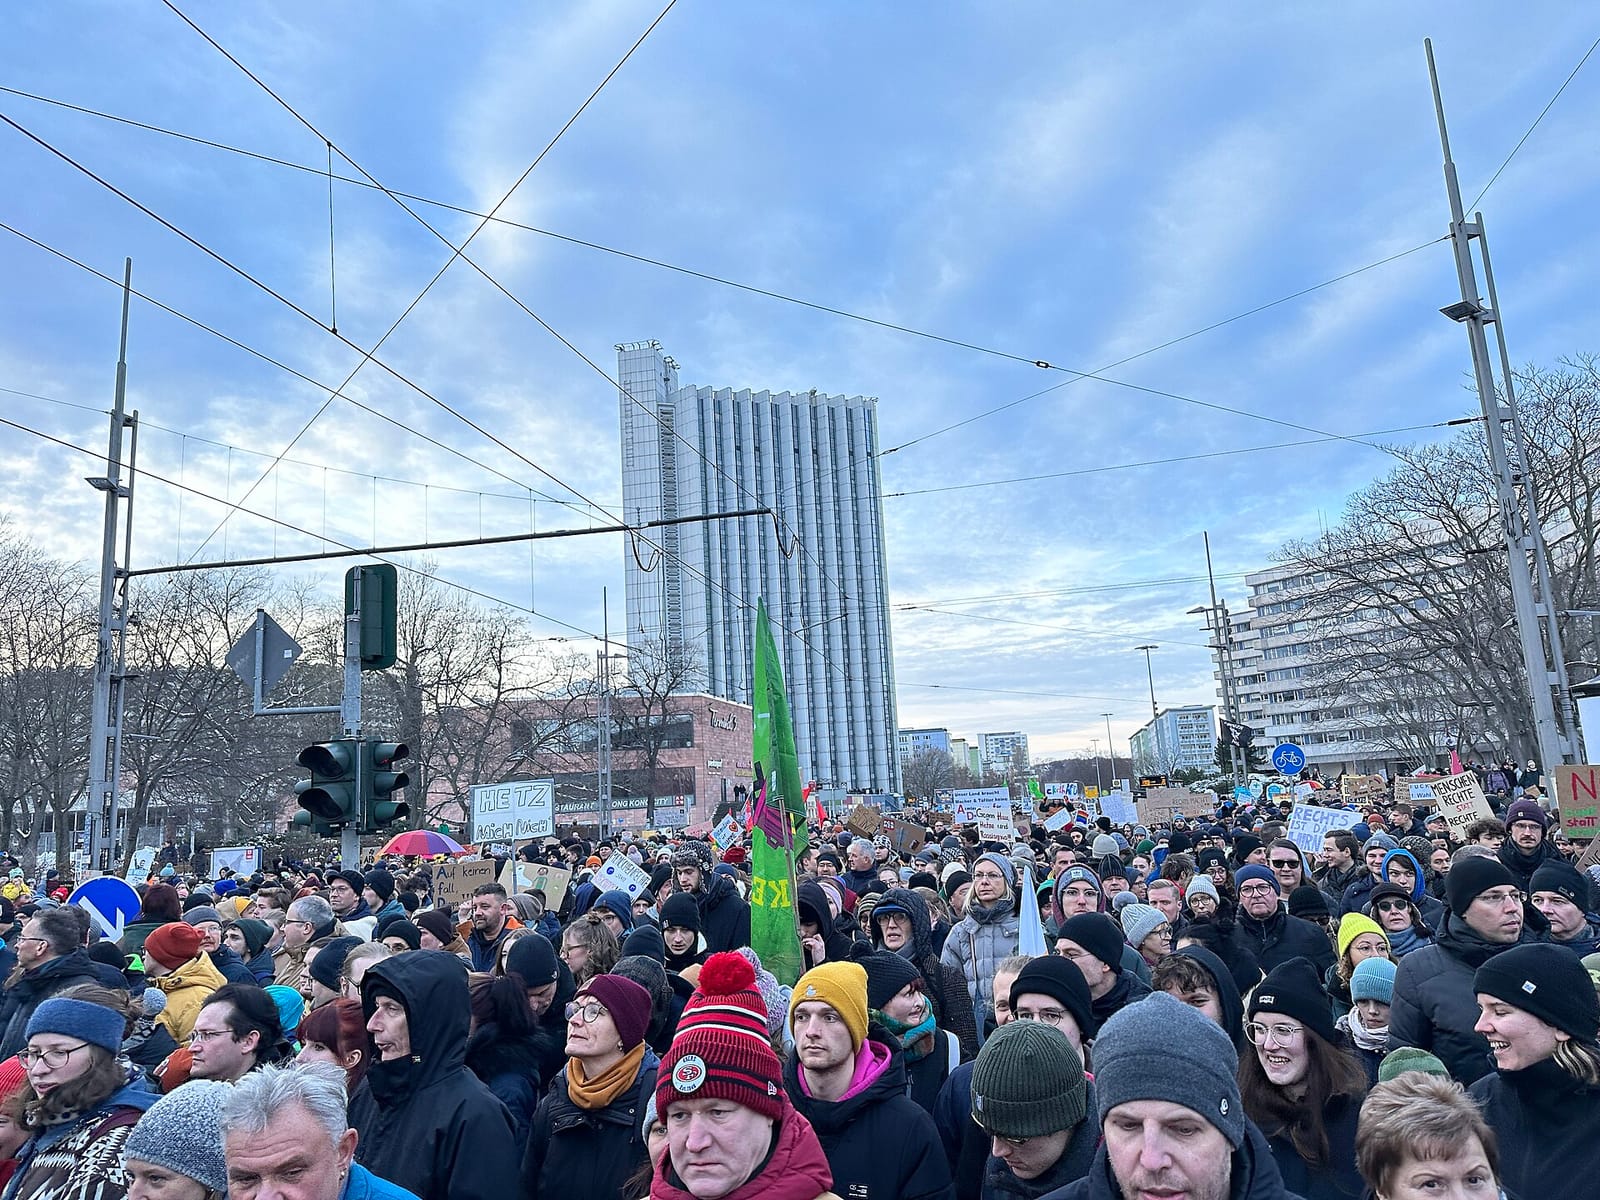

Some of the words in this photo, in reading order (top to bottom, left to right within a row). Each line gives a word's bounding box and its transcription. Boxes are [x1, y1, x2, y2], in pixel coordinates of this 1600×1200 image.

[1430, 773, 1477, 797] MENSCHEN
[1571, 768, 1600, 801] N
[479, 784, 551, 813] HETZ
[554, 801, 595, 812] STAURANT
[611, 799, 627, 809] ONG
[1441, 787, 1476, 807] RECHTE
[1455, 801, 1474, 813] STATT
[1290, 820, 1307, 831] IST
[1293, 806, 1349, 827] RECHTS
[1447, 811, 1480, 828] RECHTE
[436, 865, 456, 880] Auf
[462, 865, 491, 878] keinen
